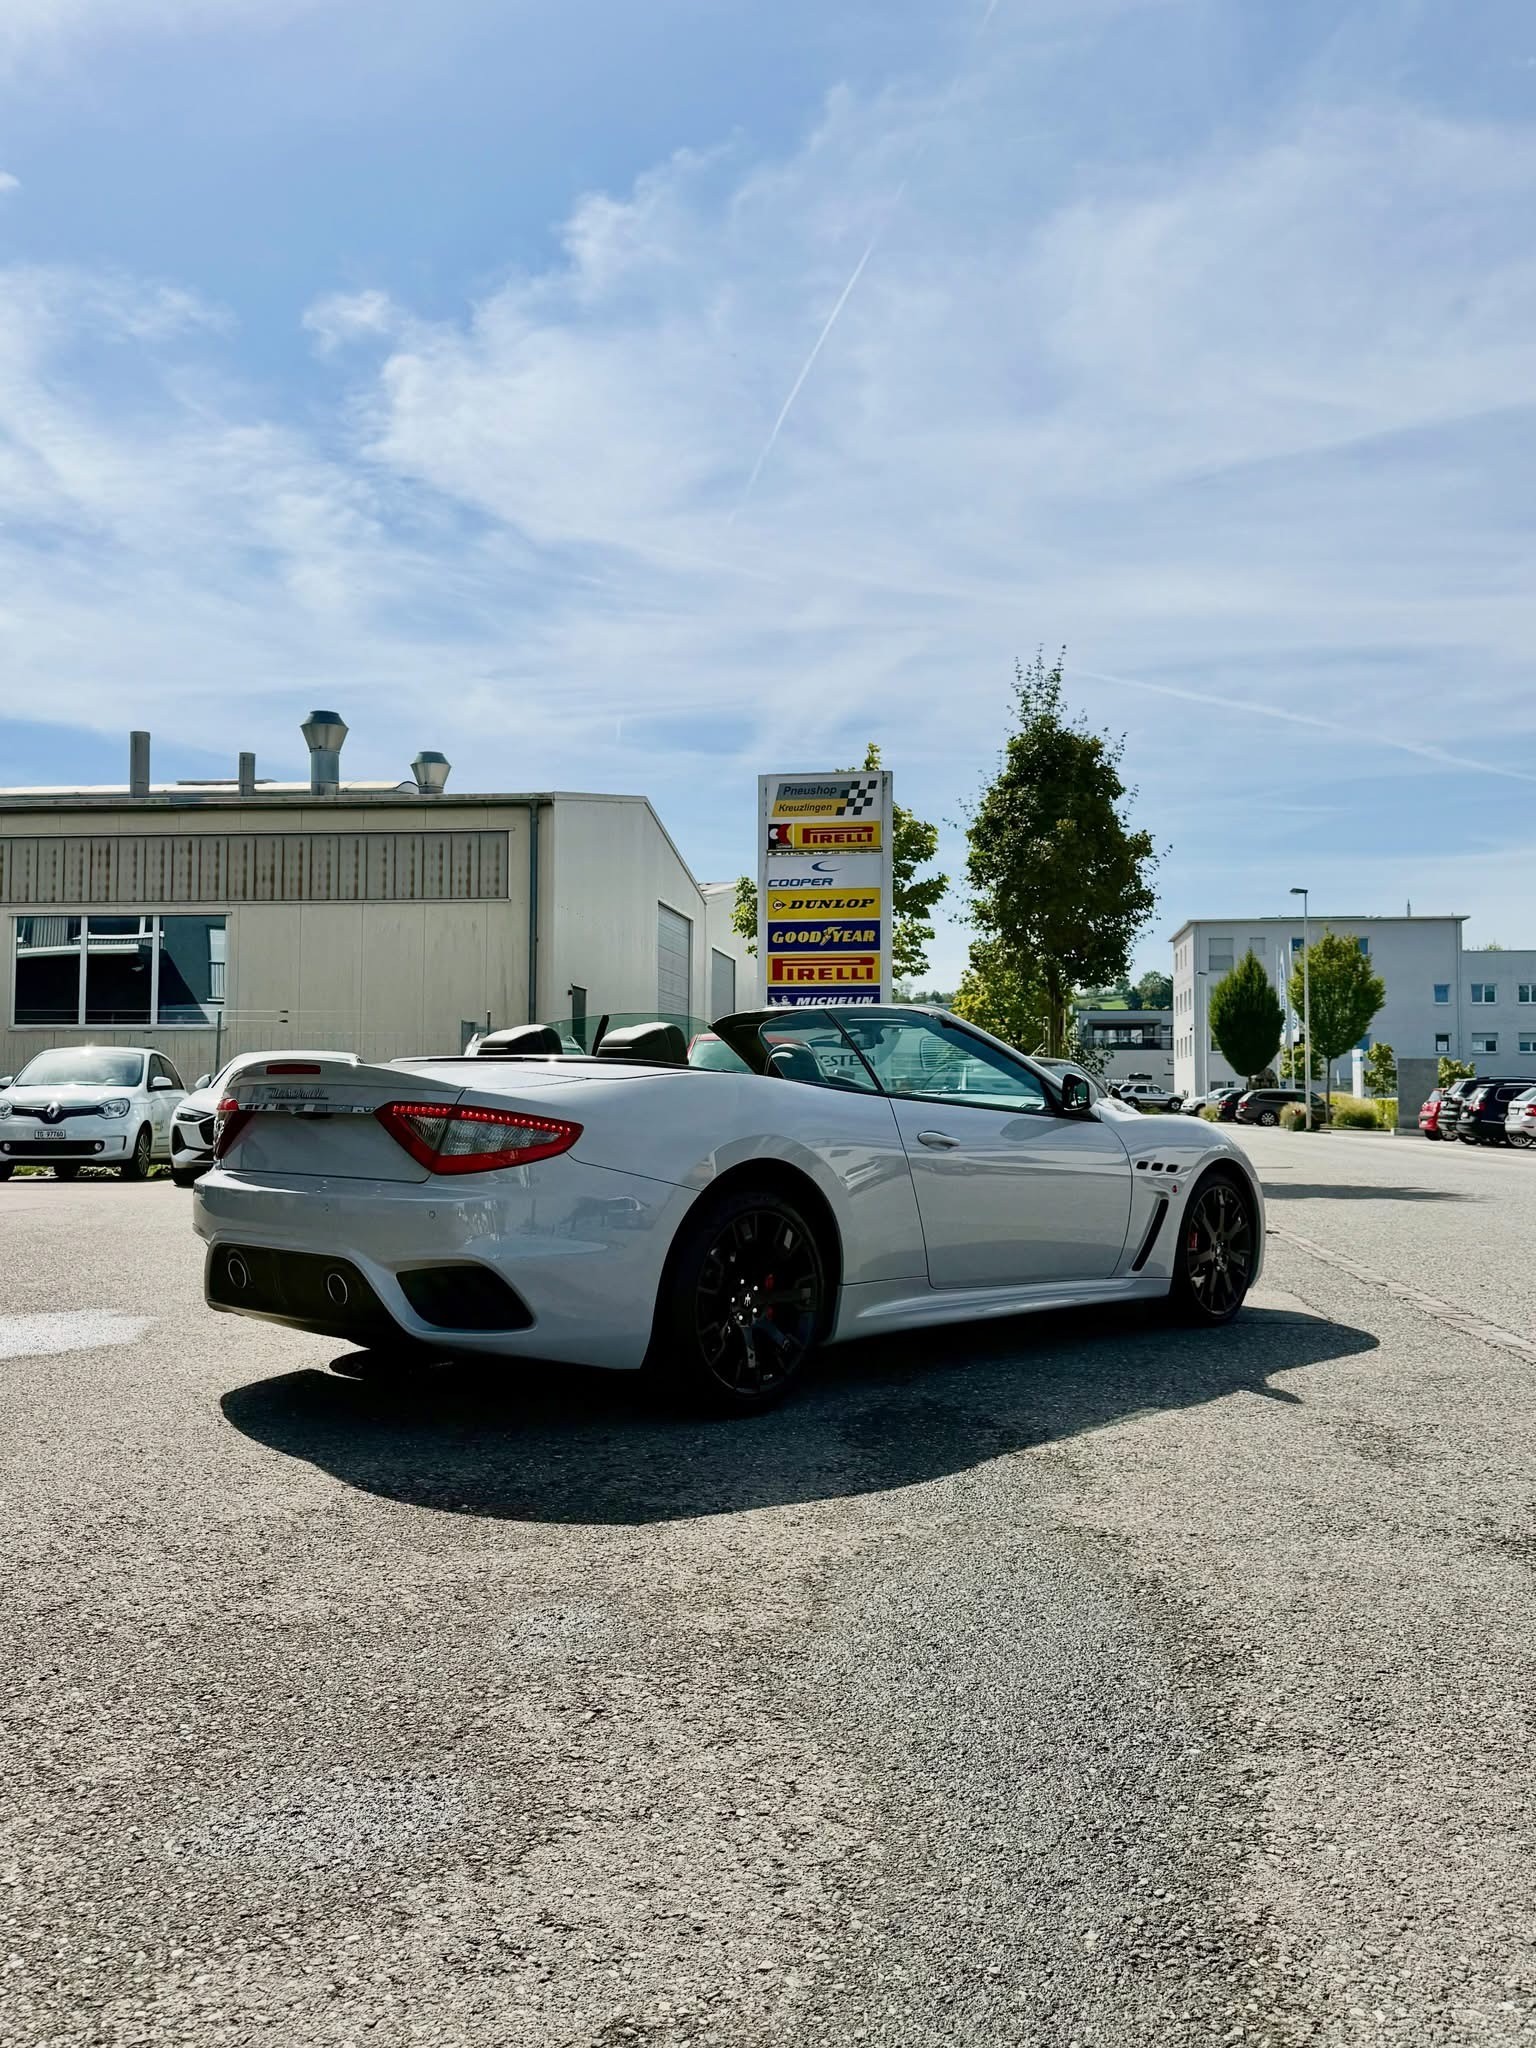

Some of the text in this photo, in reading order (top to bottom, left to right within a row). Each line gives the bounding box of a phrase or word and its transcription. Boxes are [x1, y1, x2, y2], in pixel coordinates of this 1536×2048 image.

[783, 786, 837, 796] Pneushop
[778, 803, 833, 813] Kreuzlingen
[802, 826, 874, 844] PIRELLI
[767, 877, 834, 887] COOPER
[788, 898, 875, 909] DUNLOP
[772, 957, 875, 981] PIRELLI
[795, 996, 874, 1006] MICHELIN
[820, 1054, 876, 1067] ESTEN
